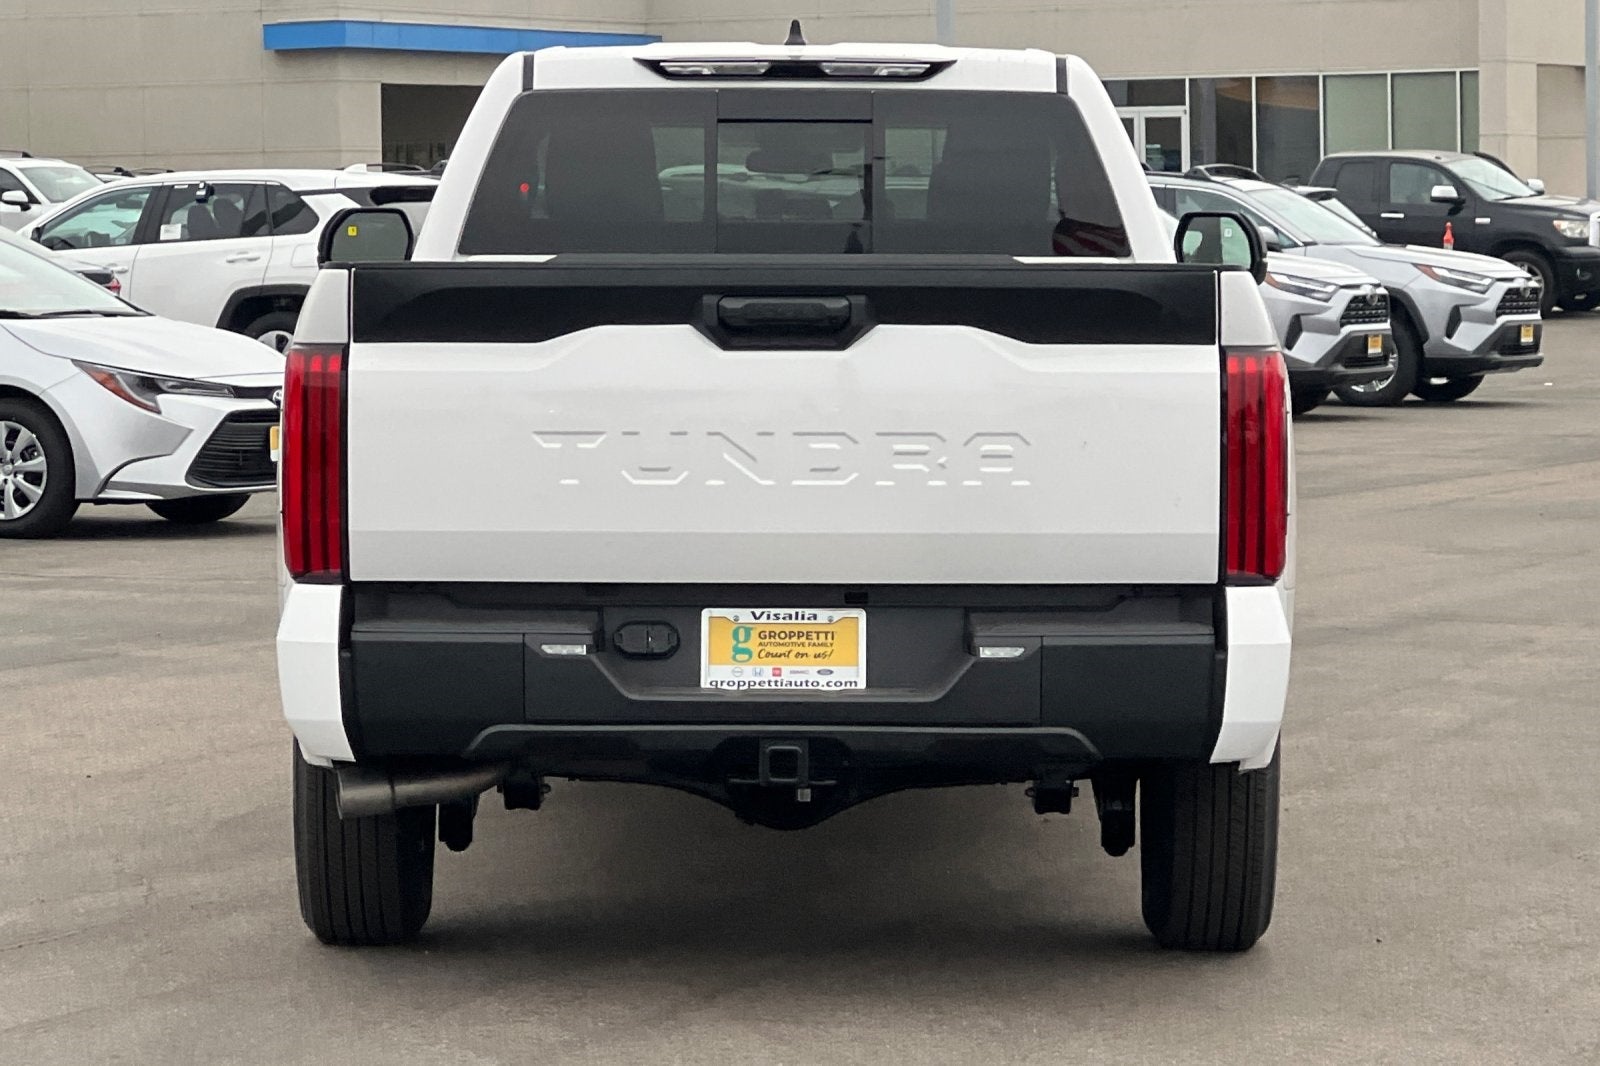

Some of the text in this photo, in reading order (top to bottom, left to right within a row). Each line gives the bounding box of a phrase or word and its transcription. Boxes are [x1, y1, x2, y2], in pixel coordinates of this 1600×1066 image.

[532, 430, 1031, 486] TUNDRA
[751, 610, 818, 621] Visalia
[758, 630, 835, 641] GROPPETTI
[758, 648, 834, 660] Count on us!
[709, 678, 858, 689] groppettiauto.com
